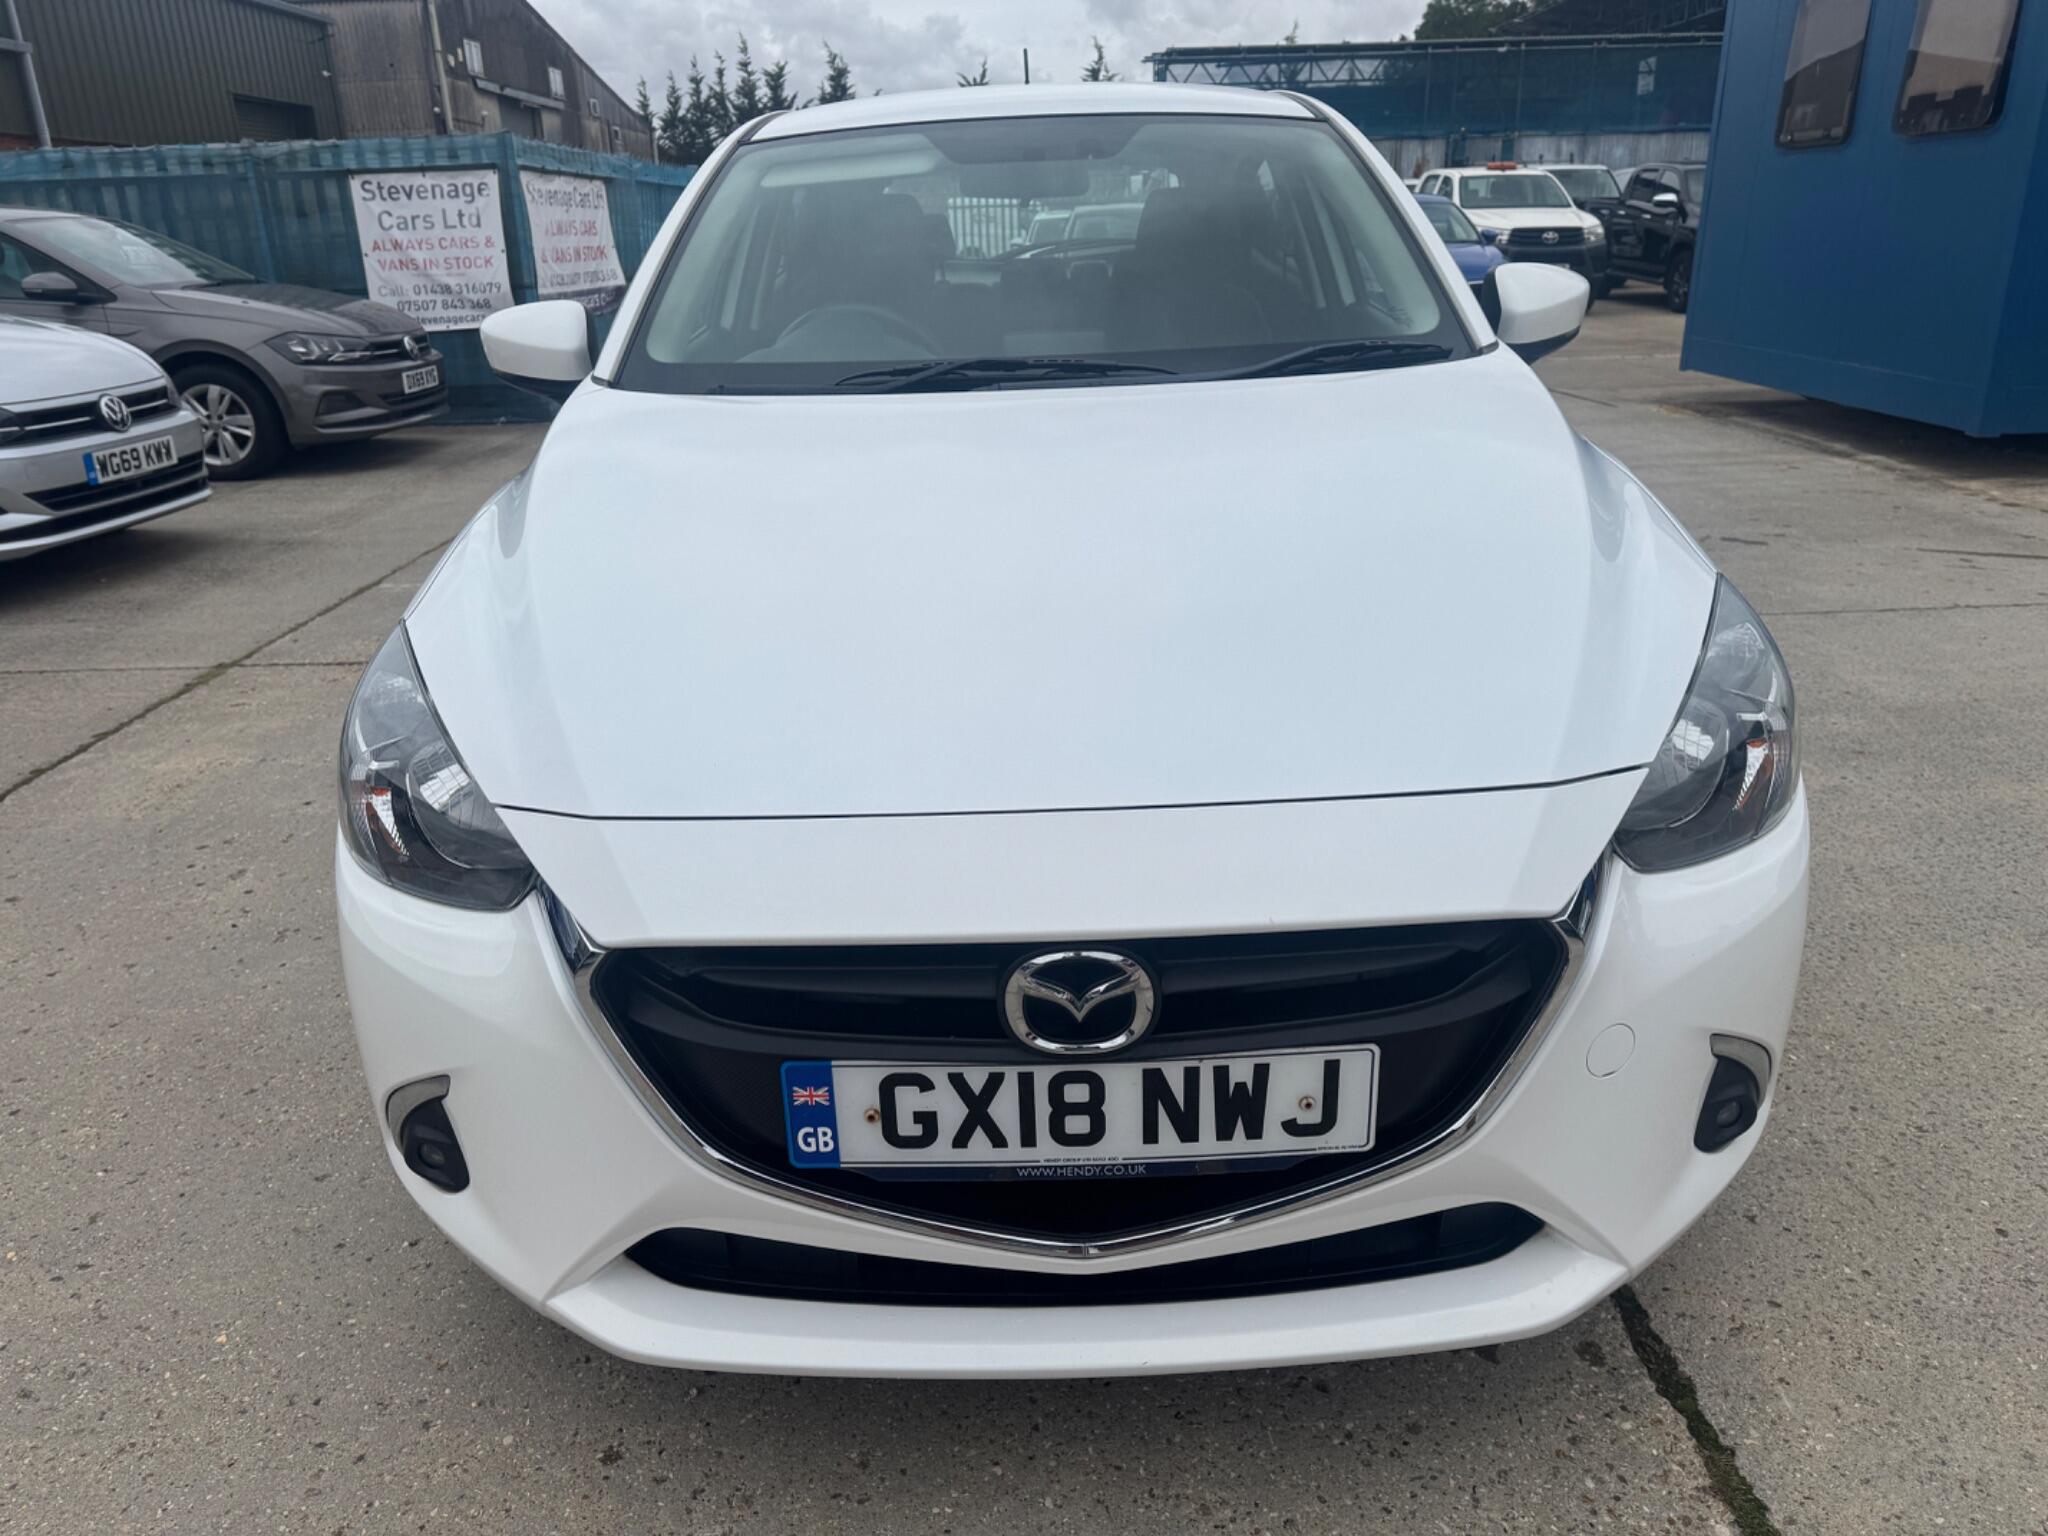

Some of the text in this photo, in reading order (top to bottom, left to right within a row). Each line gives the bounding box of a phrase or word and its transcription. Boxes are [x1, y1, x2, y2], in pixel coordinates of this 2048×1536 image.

[360, 179, 491, 204] Stevenage
[377, 208, 482, 232] Cars Ltd
[372, 235, 496, 253] ALWAYS CARS &
[377, 256, 495, 272] VANS IN STOCK
[377, 282, 501, 298] Call: 01438 316079
[396, 298, 492, 313] 07507 843 368
[96, 438, 174, 479] WG69 KWW
[878, 1058, 1341, 1150] GX18 NWJ
[797, 1126, 835, 1153] GB
[1016, 1164, 1147, 1177] WWW.HENDY.CO.UK
